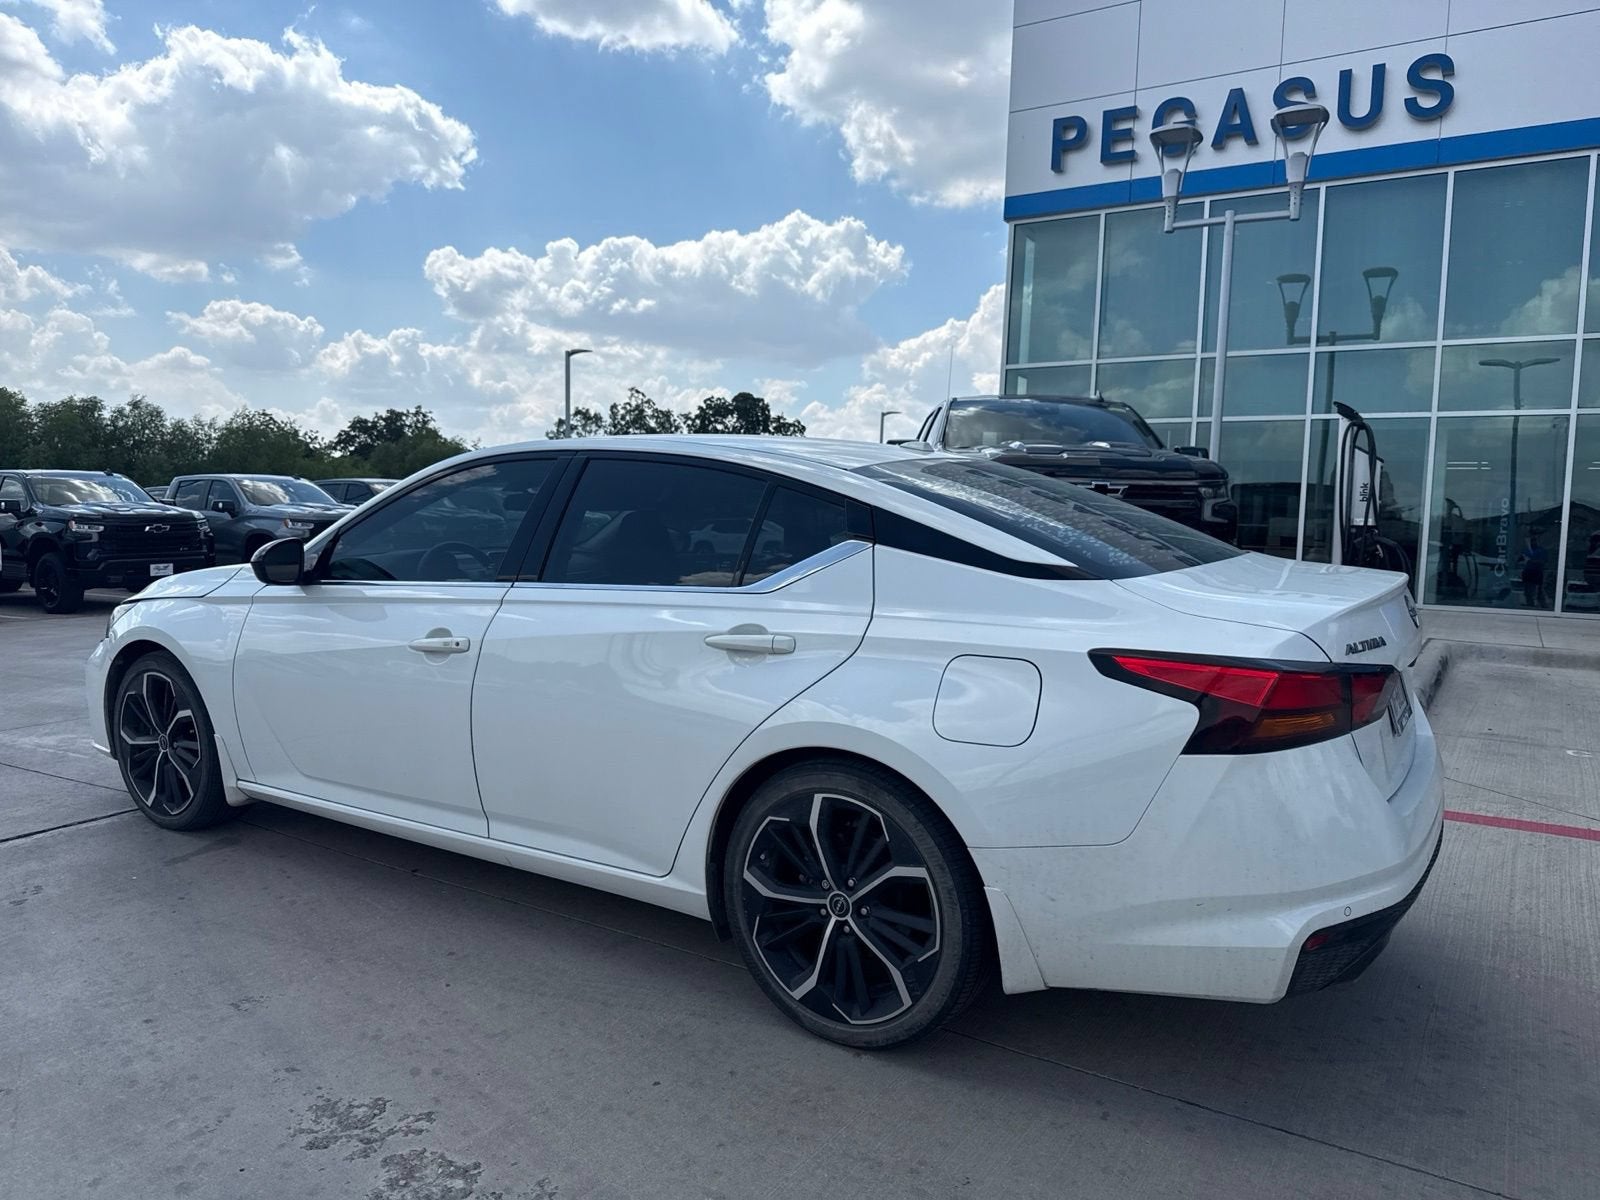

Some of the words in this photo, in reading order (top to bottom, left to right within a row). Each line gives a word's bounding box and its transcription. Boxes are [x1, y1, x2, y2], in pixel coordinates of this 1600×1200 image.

[1051, 53, 1455, 173] PEGASUS
[1359, 482, 1369, 502] blink
[1345, 636, 1387, 656] ALTIMA
